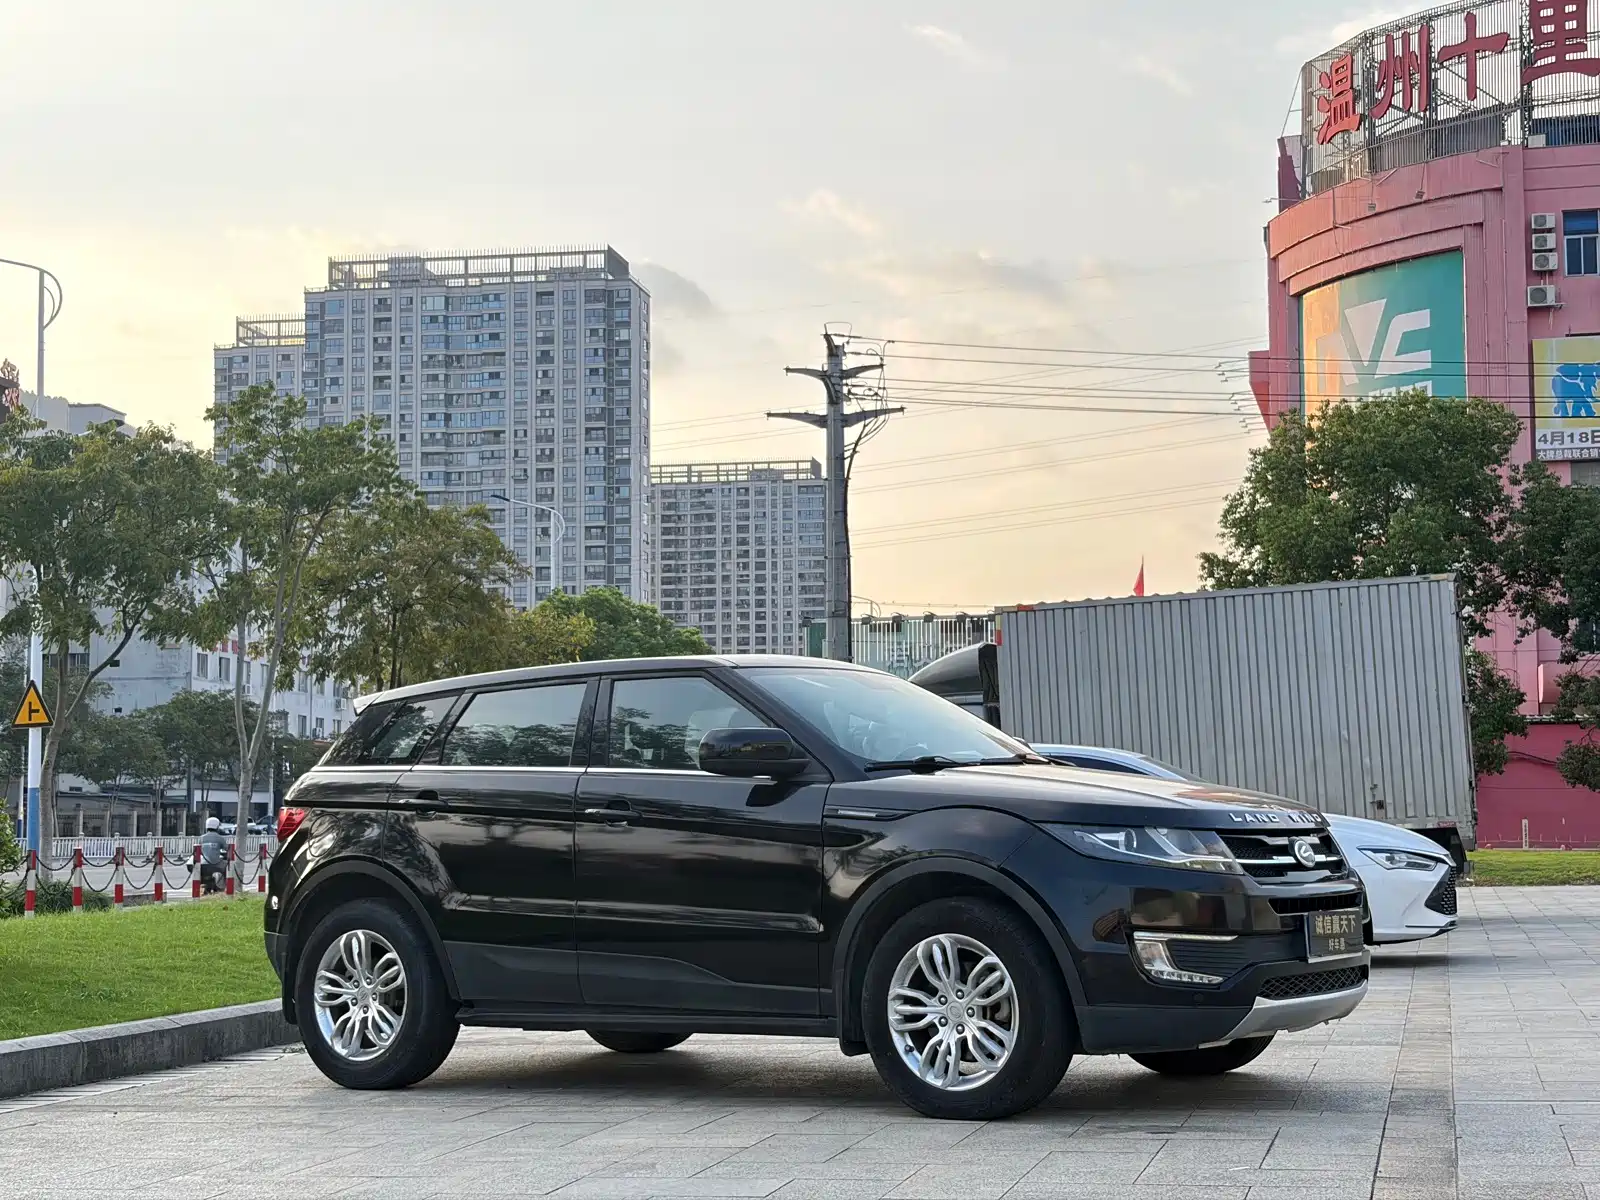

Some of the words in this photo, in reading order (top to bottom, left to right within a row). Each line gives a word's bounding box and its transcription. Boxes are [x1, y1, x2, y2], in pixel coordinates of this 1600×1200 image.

[1316, 0, 1600, 145] 温州十里
[1537, 429, 1600, 446] 4月18日
[1537, 448, 1600, 460] 大牌总裁联合销
[1228, 812, 1280, 823] LAND
[1287, 812, 1322, 823] WIND
